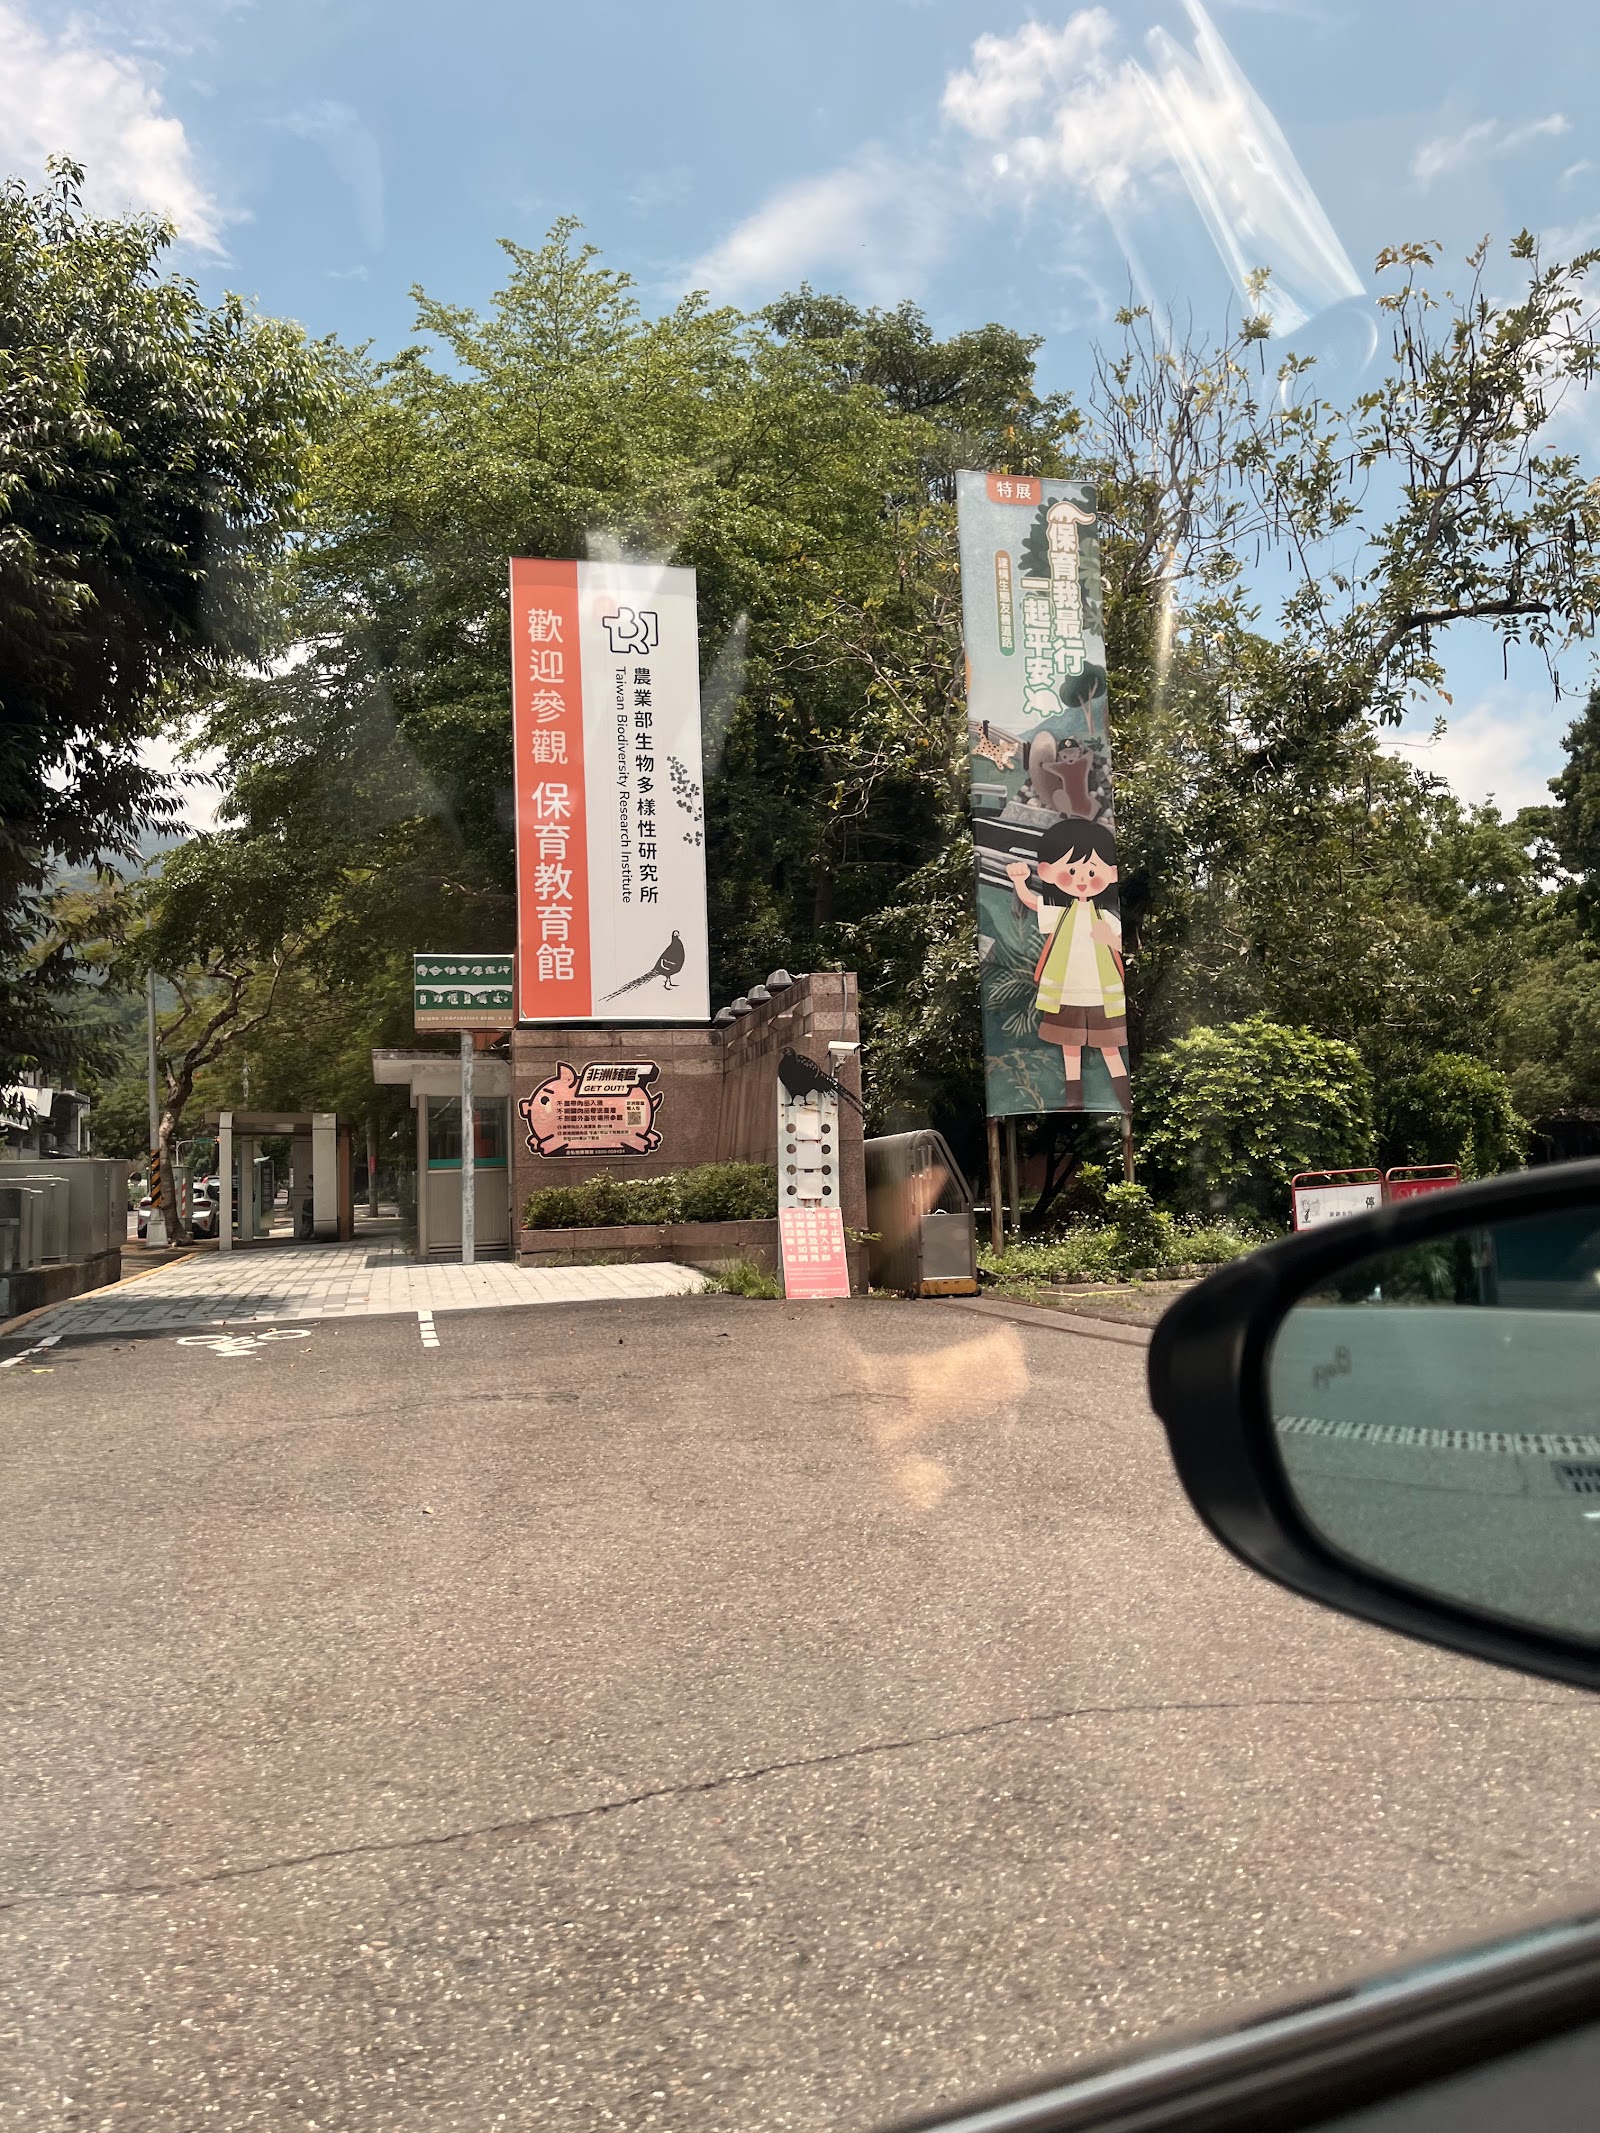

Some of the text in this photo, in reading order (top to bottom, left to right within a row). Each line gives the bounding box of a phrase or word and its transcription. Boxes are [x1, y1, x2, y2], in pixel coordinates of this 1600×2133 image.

[996, 481, 1032, 500] 特展
[1020, 577, 1055, 687] 一起平安
[527, 608, 575, 982] 歡迎參觀 保育教育館
[615, 666, 633, 903] Taiwan Biodiversity Research Institute
[633, 667, 659, 903] 農業部生物多樣性研究所
